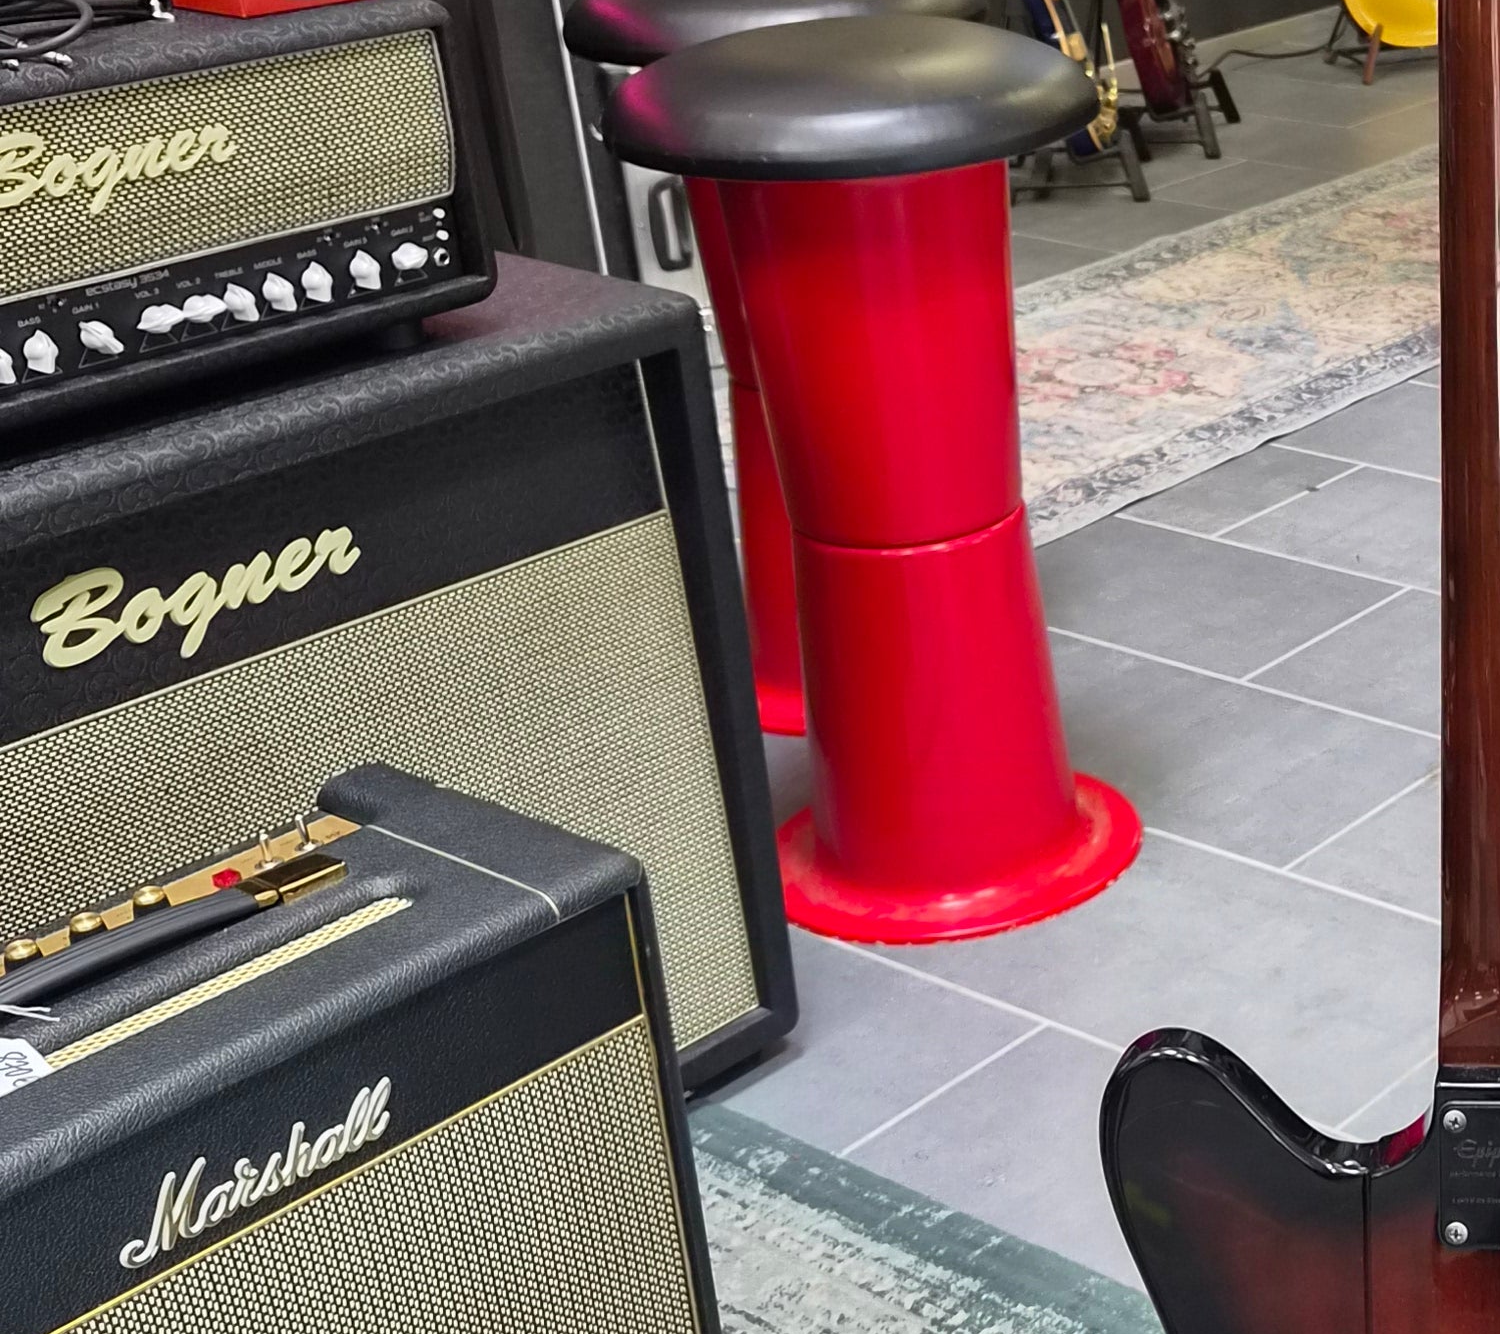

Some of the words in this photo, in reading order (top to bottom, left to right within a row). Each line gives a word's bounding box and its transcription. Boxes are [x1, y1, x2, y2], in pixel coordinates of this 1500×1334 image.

[0, 123, 237, 216] Bogner
[72, 304, 94, 315] GAIN
[85, 276, 138, 297] ecstasy
[17, 316, 42, 329] BASS
[30, 526, 362, 668] Bogner
[119, 1076, 392, 1269] Marshall
